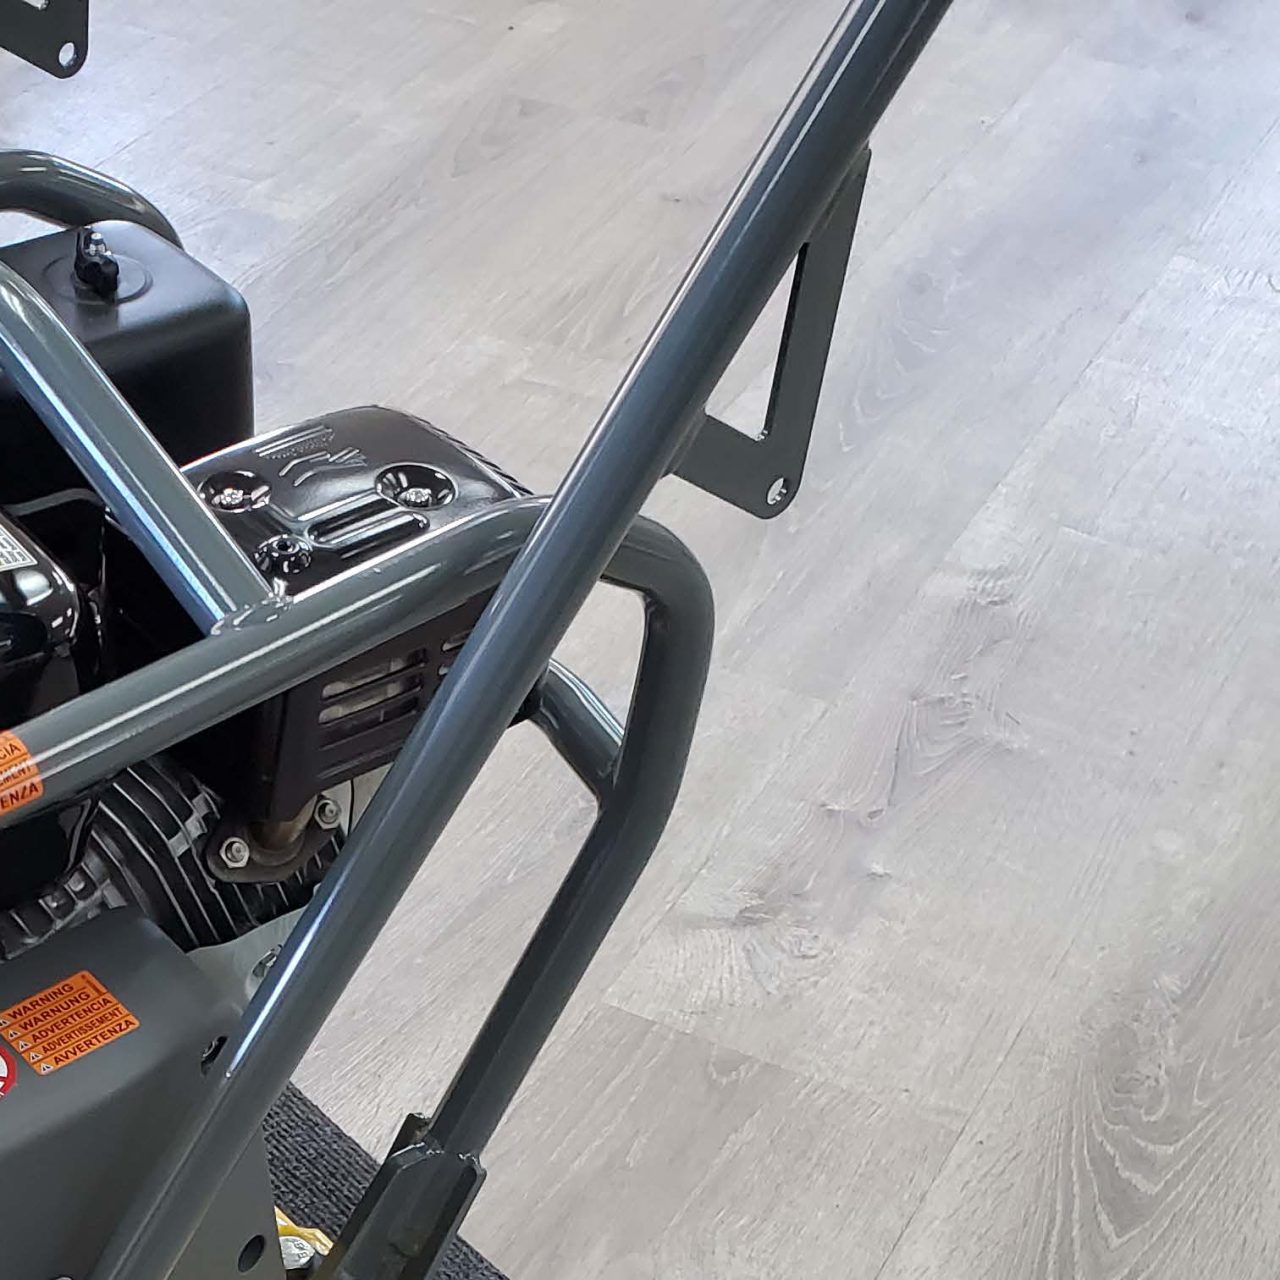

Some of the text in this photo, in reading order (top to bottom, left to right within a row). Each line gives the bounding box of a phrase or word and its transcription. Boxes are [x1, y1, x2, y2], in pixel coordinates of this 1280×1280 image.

[8, 983, 74, 1020] WARNING
[19, 991, 91, 1031] WARNUNG
[32, 997, 112, 1043] ADVERTENCIA
[42, 1007, 124, 1054] ADVERTISSEMENT
[53, 1019, 135, 1066] AVVERTENZA
